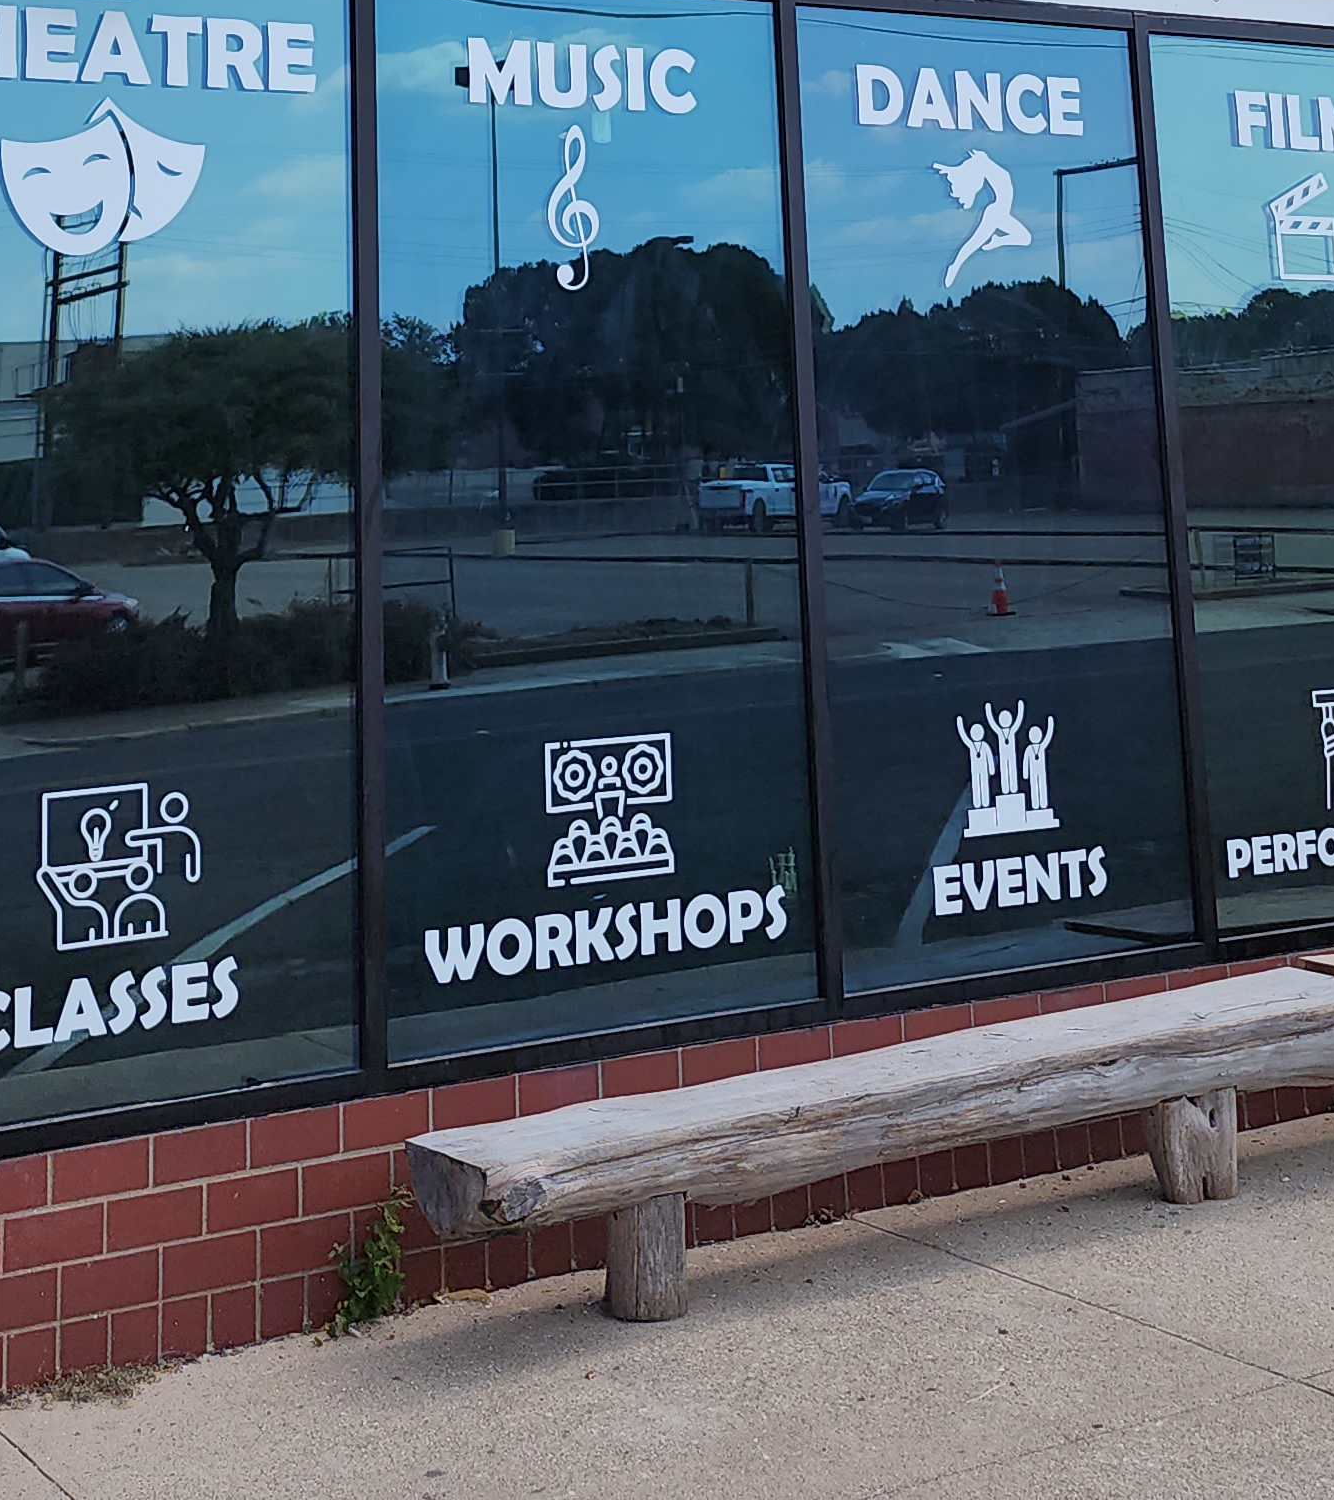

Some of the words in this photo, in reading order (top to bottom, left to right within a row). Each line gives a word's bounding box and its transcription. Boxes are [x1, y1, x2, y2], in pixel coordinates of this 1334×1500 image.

[467, 37, 696, 114] MUSIC
[854, 64, 1084, 136] DANCE
[931, 845, 1108, 918] EVENTS
[424, 884, 788, 984] WORKSHOPS
